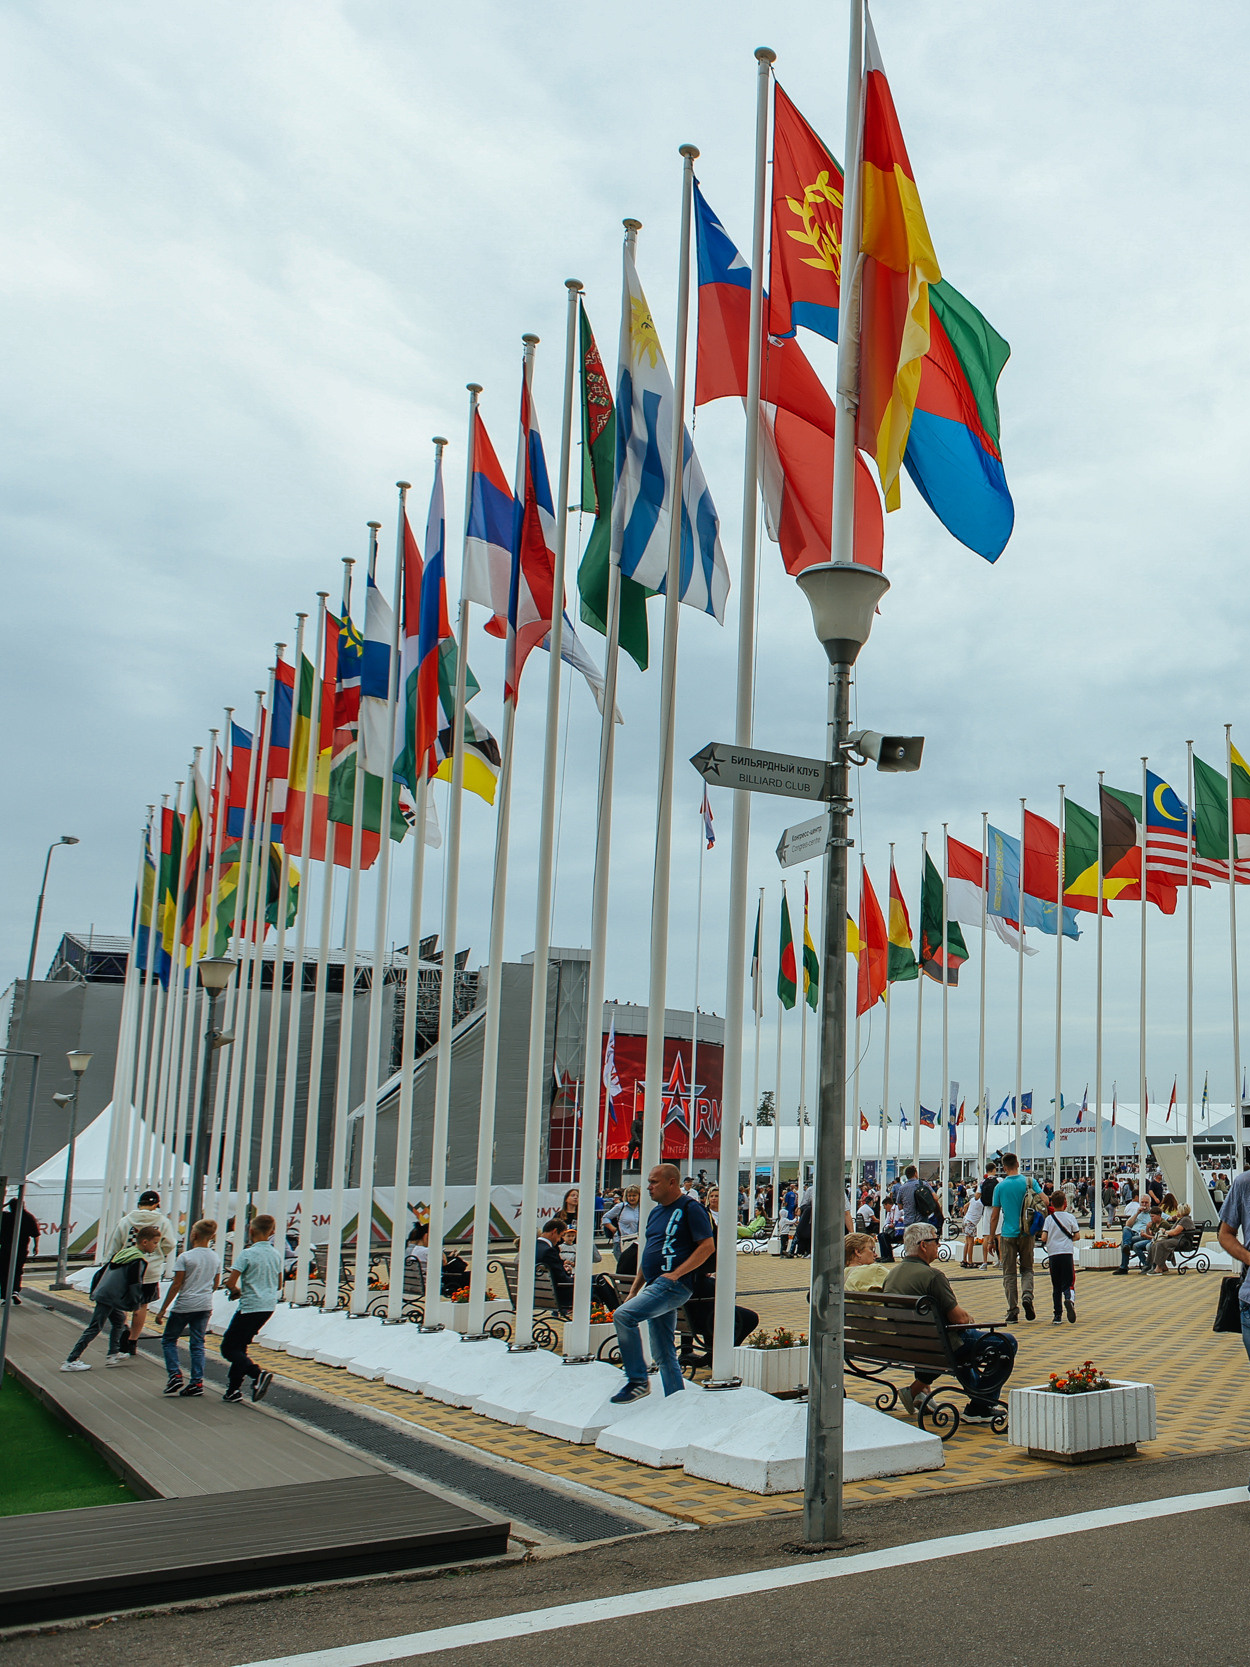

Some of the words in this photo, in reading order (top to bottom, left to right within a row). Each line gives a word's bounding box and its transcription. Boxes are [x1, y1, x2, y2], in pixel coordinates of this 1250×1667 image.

[731, 755, 795, 773] БИЛЬЯРДНЫЙ
[797, 766, 819, 777] КЛУБ
[739, 773, 783, 788] BILLIARD
[785, 781, 811, 792] CLUB
